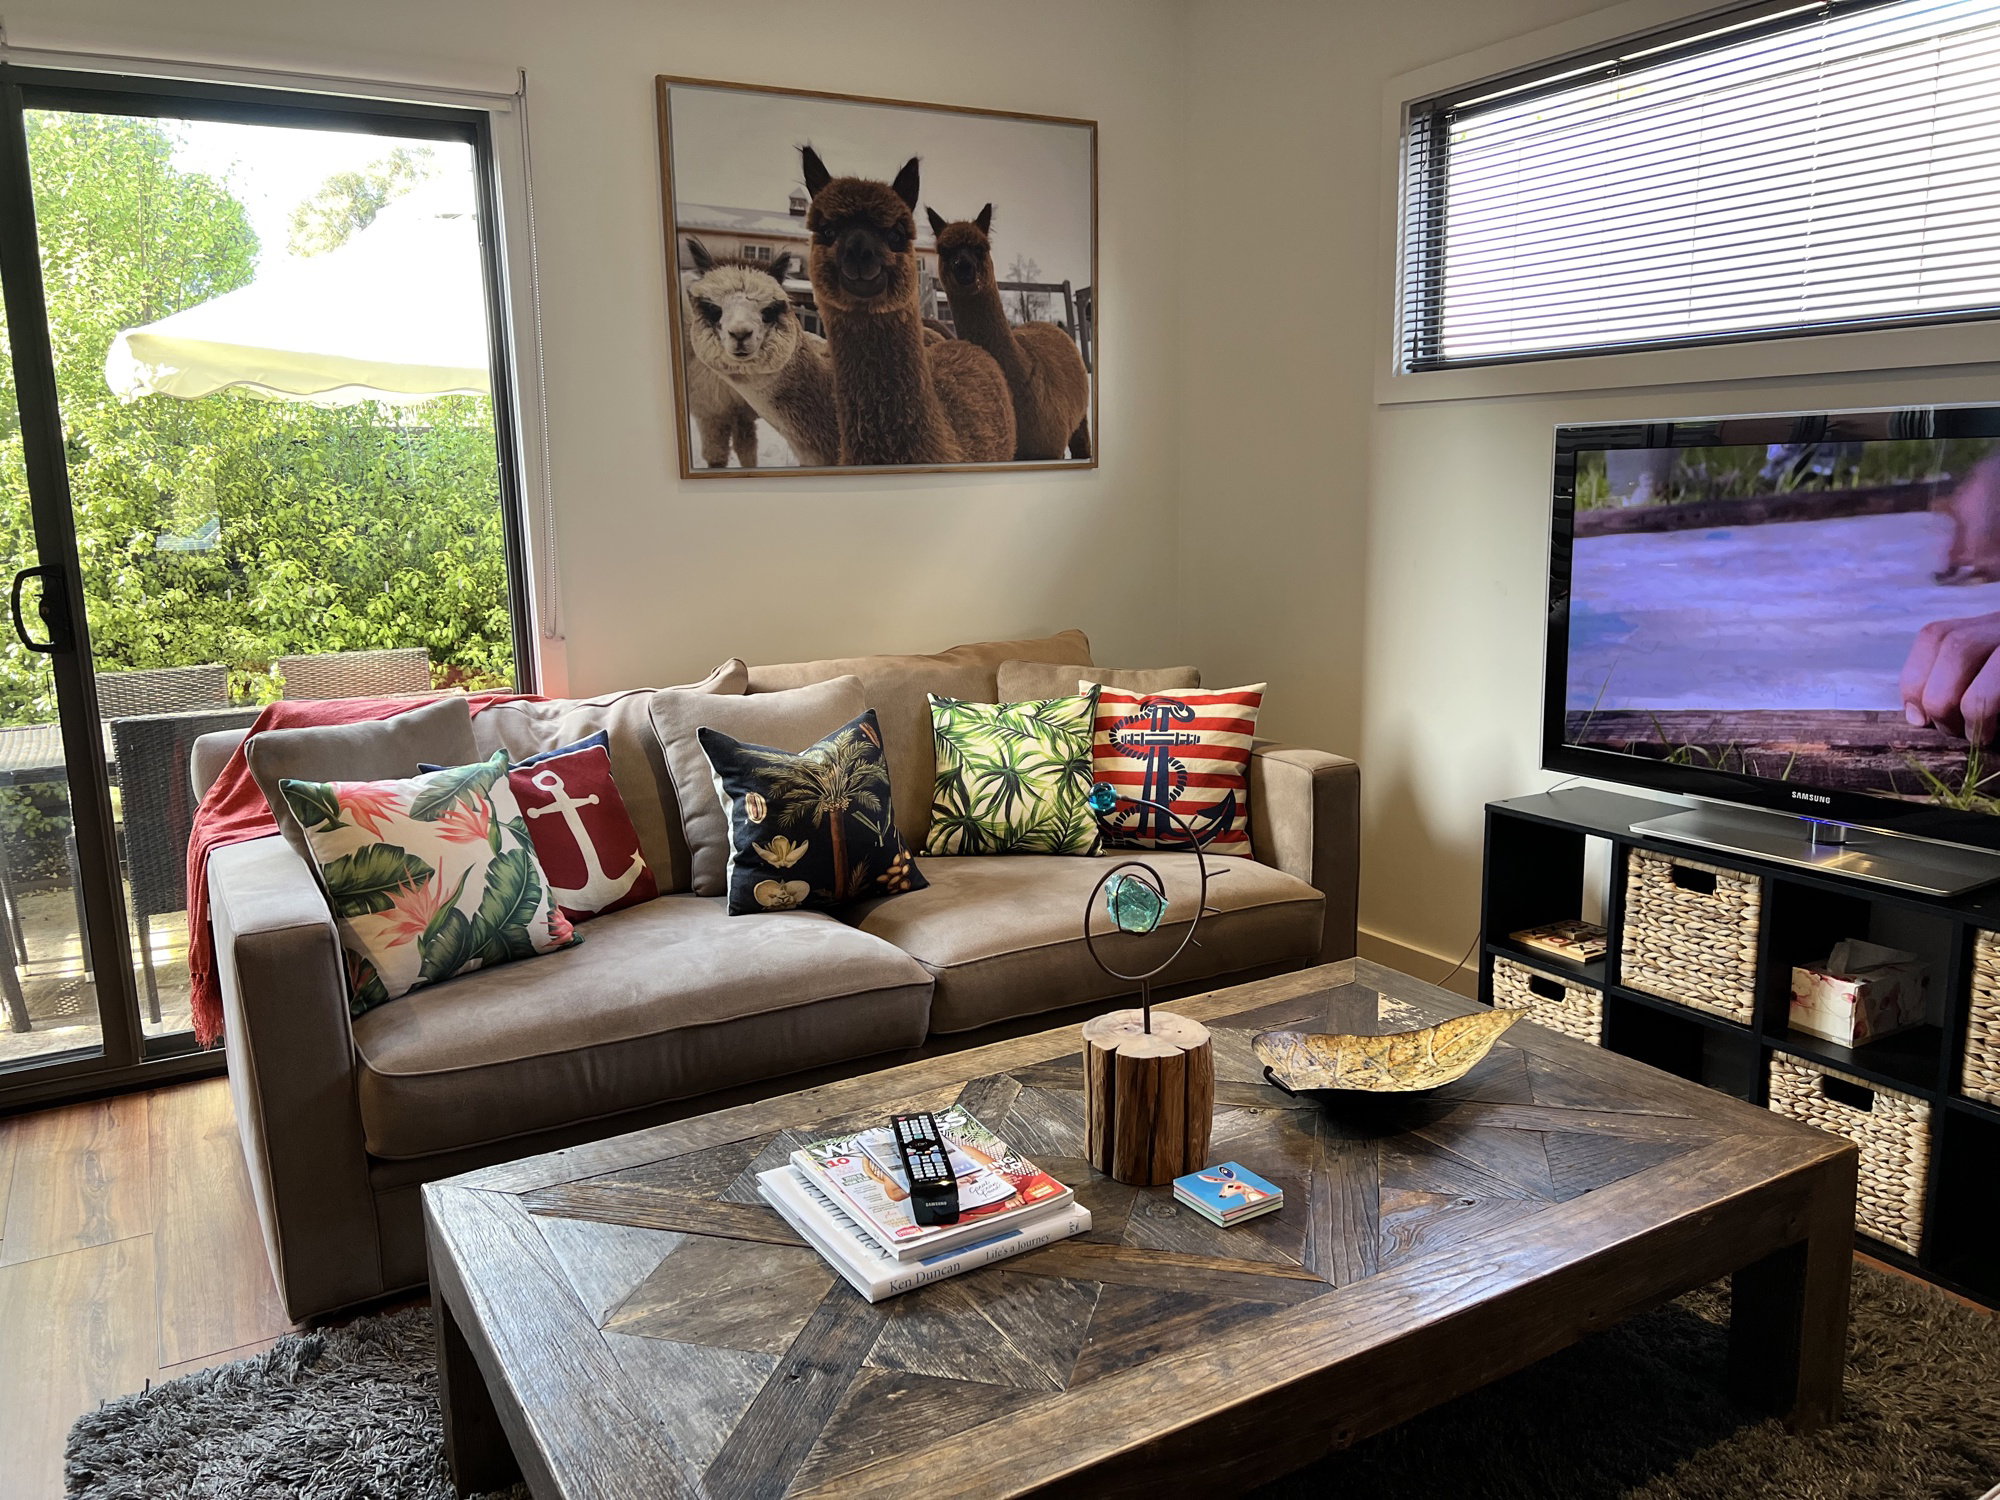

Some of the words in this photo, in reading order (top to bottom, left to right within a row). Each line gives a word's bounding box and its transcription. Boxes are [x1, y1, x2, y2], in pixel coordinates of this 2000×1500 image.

[1791, 791, 1831, 804] SAMSUNG
[826, 1157, 850, 1168] 10
[889, 1278, 912, 1293] Ken
[915, 1262, 961, 1285] Duncan
[985, 1246, 1008, 1261] Life's
[1017, 1232, 1051, 1251] Journey
